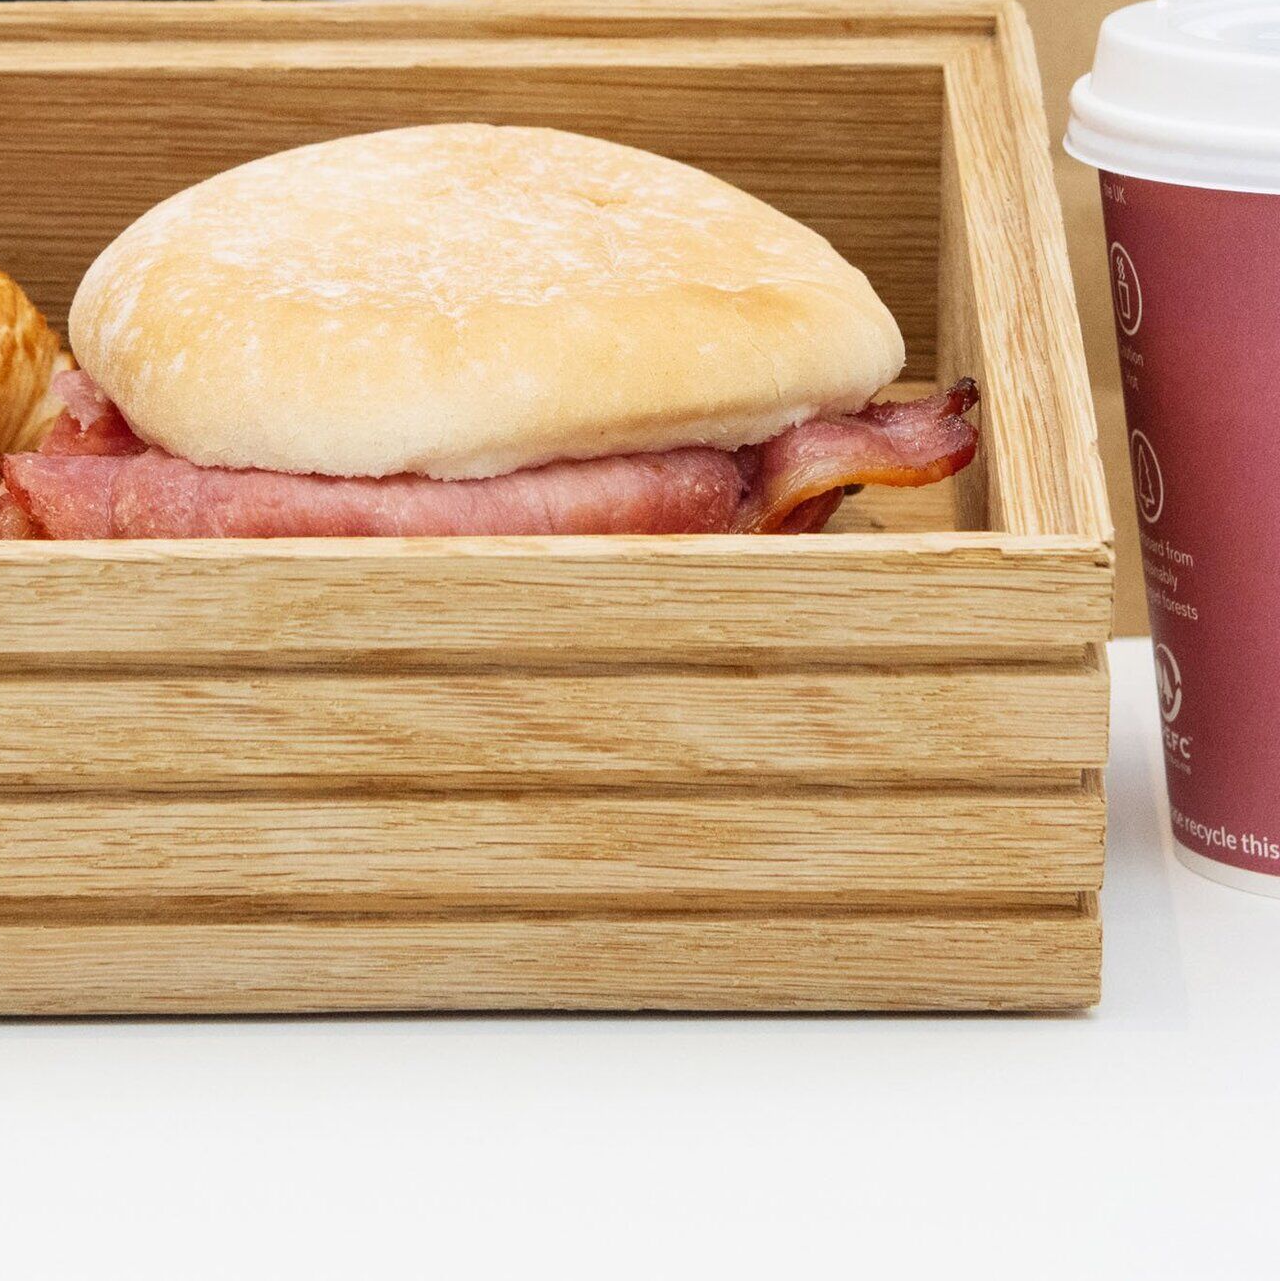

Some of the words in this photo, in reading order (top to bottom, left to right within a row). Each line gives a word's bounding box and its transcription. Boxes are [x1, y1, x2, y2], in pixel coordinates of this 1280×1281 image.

[1166, 540, 1194, 568] from
[1161, 590, 1199, 621] forests
[1184, 816, 1237, 850] recycle
[1240, 833, 1280, 860] this
